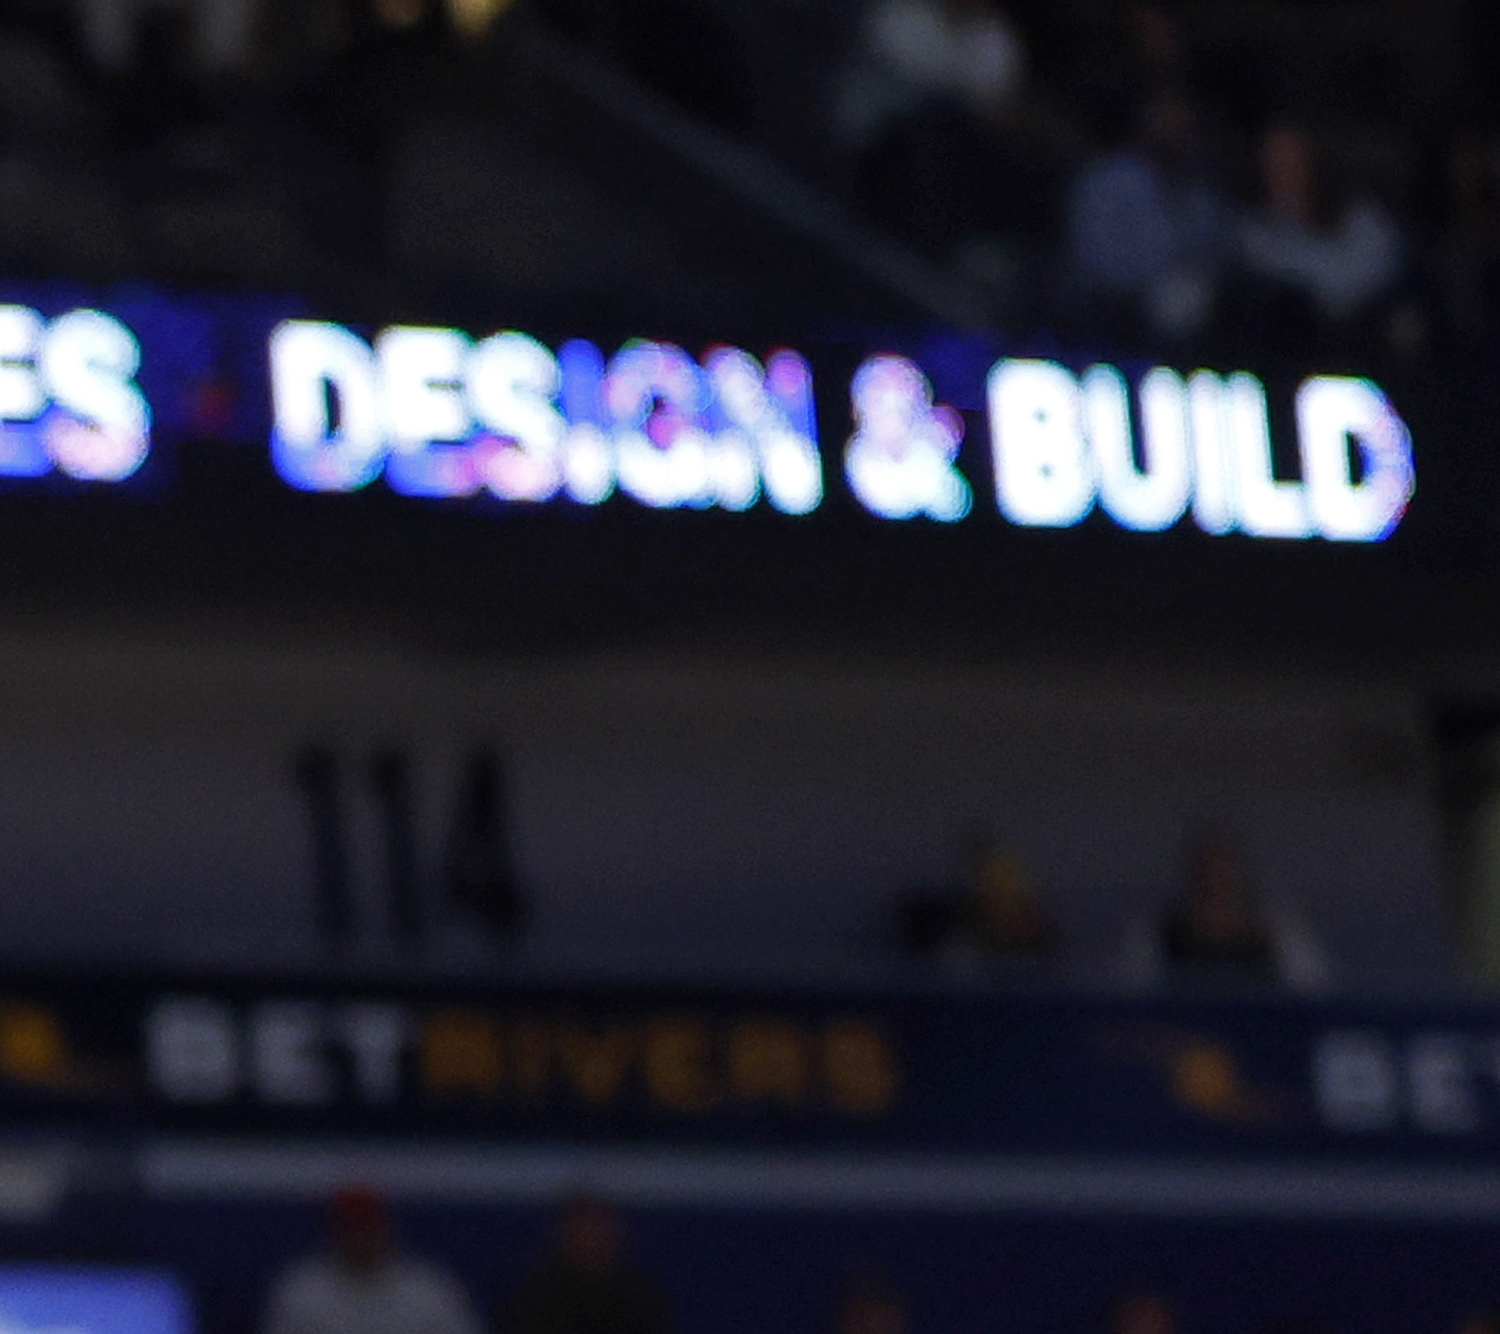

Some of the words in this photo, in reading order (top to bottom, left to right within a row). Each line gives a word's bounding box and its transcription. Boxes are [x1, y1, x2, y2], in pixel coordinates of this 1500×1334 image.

[270, 319, 825, 516] DESIGN
[844, 352, 973, 523] &
[986, 357, 1415, 544] BUILD
